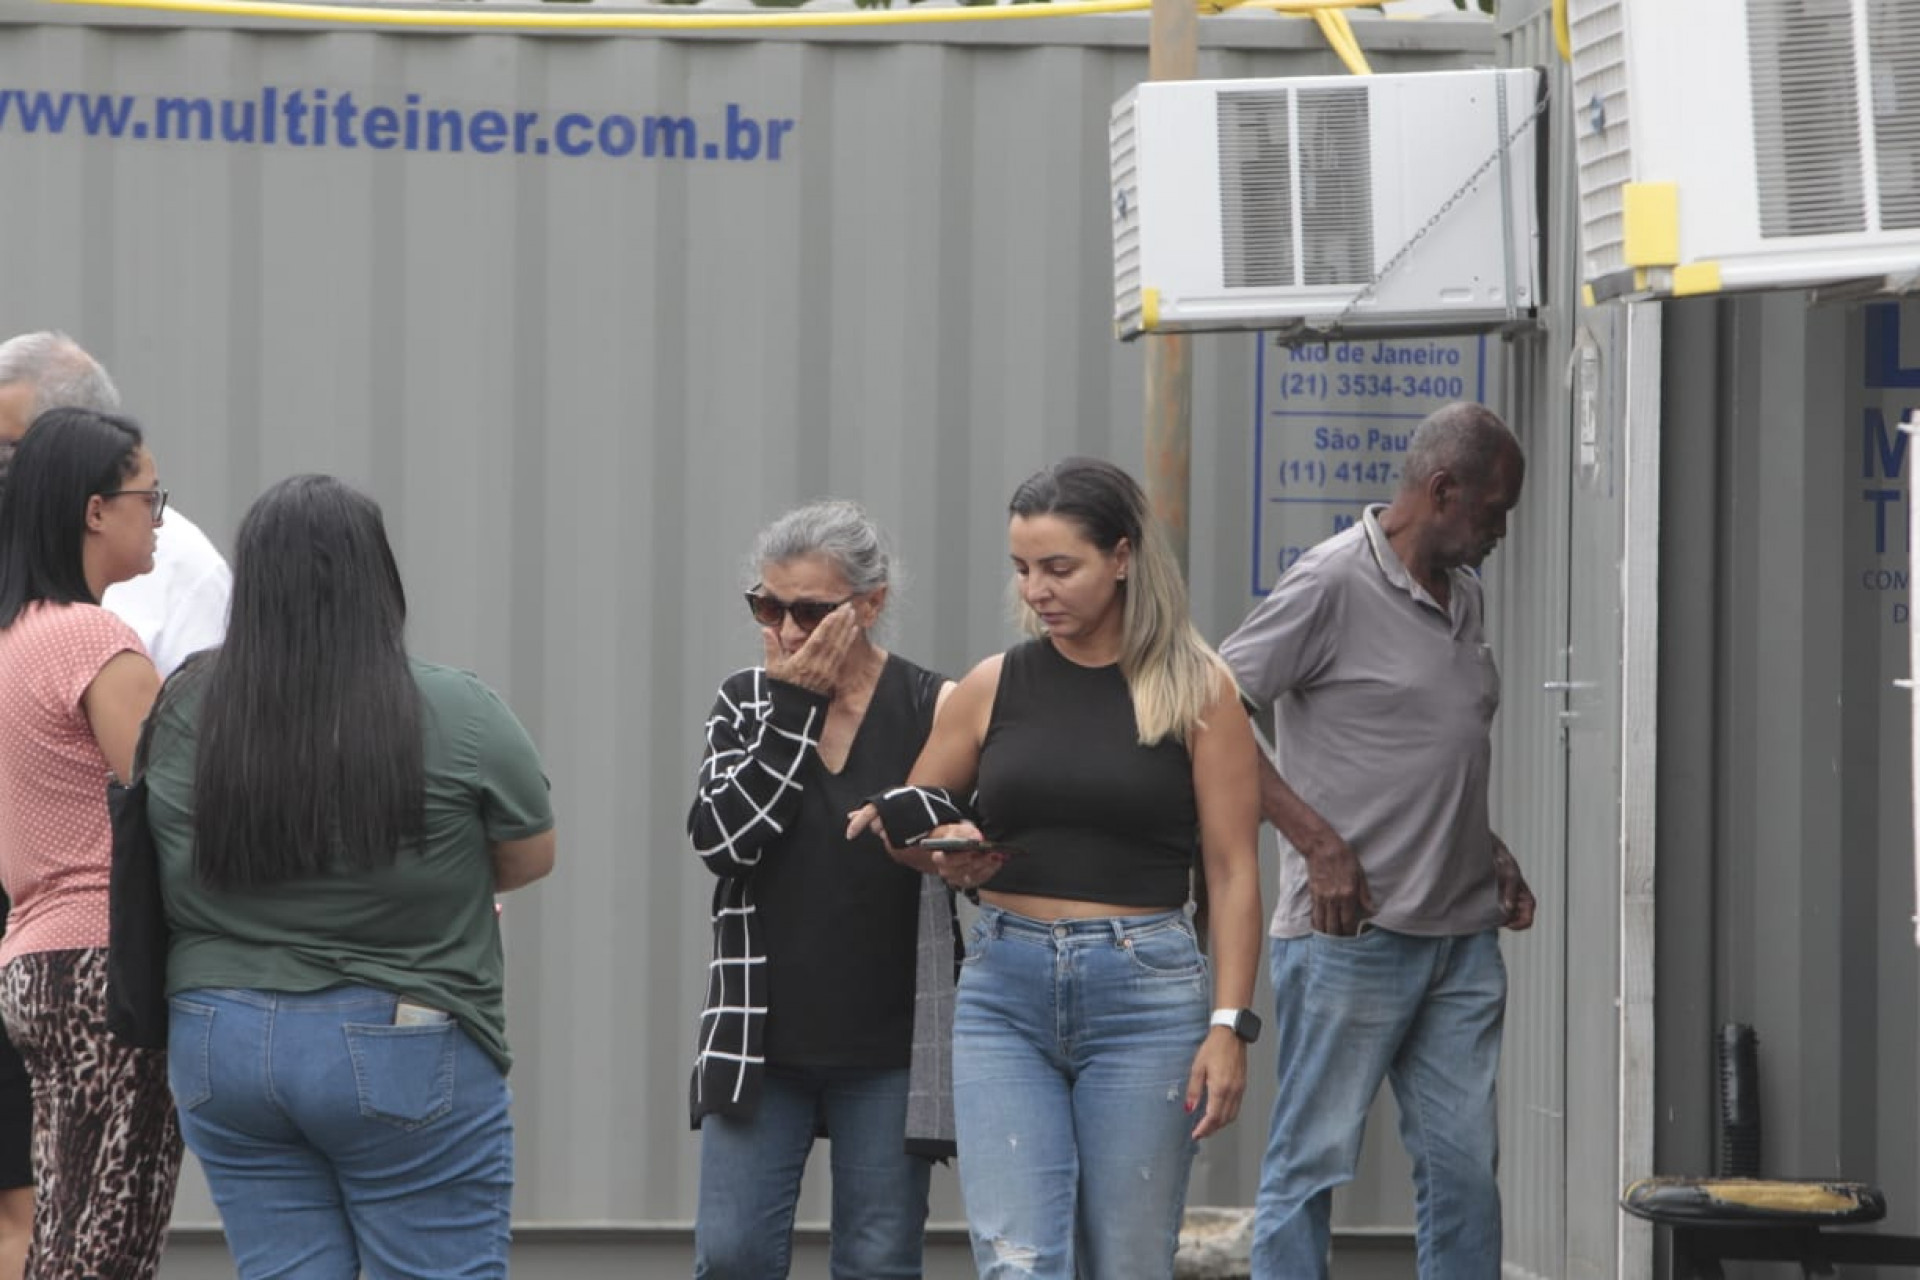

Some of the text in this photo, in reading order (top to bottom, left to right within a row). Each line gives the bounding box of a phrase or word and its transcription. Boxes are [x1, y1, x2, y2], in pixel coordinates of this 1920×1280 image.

[0, 86, 796, 161] ww.multiteiner.com.br
[1289, 341, 1460, 365] Rio de Janeiro
[1281, 373, 1463, 399] (21) 3534-3400
[1314, 426, 1416, 452] São Pau
[1279, 460, 1400, 488] (11) 4147-
[1862, 570, 1910, 591] COM
